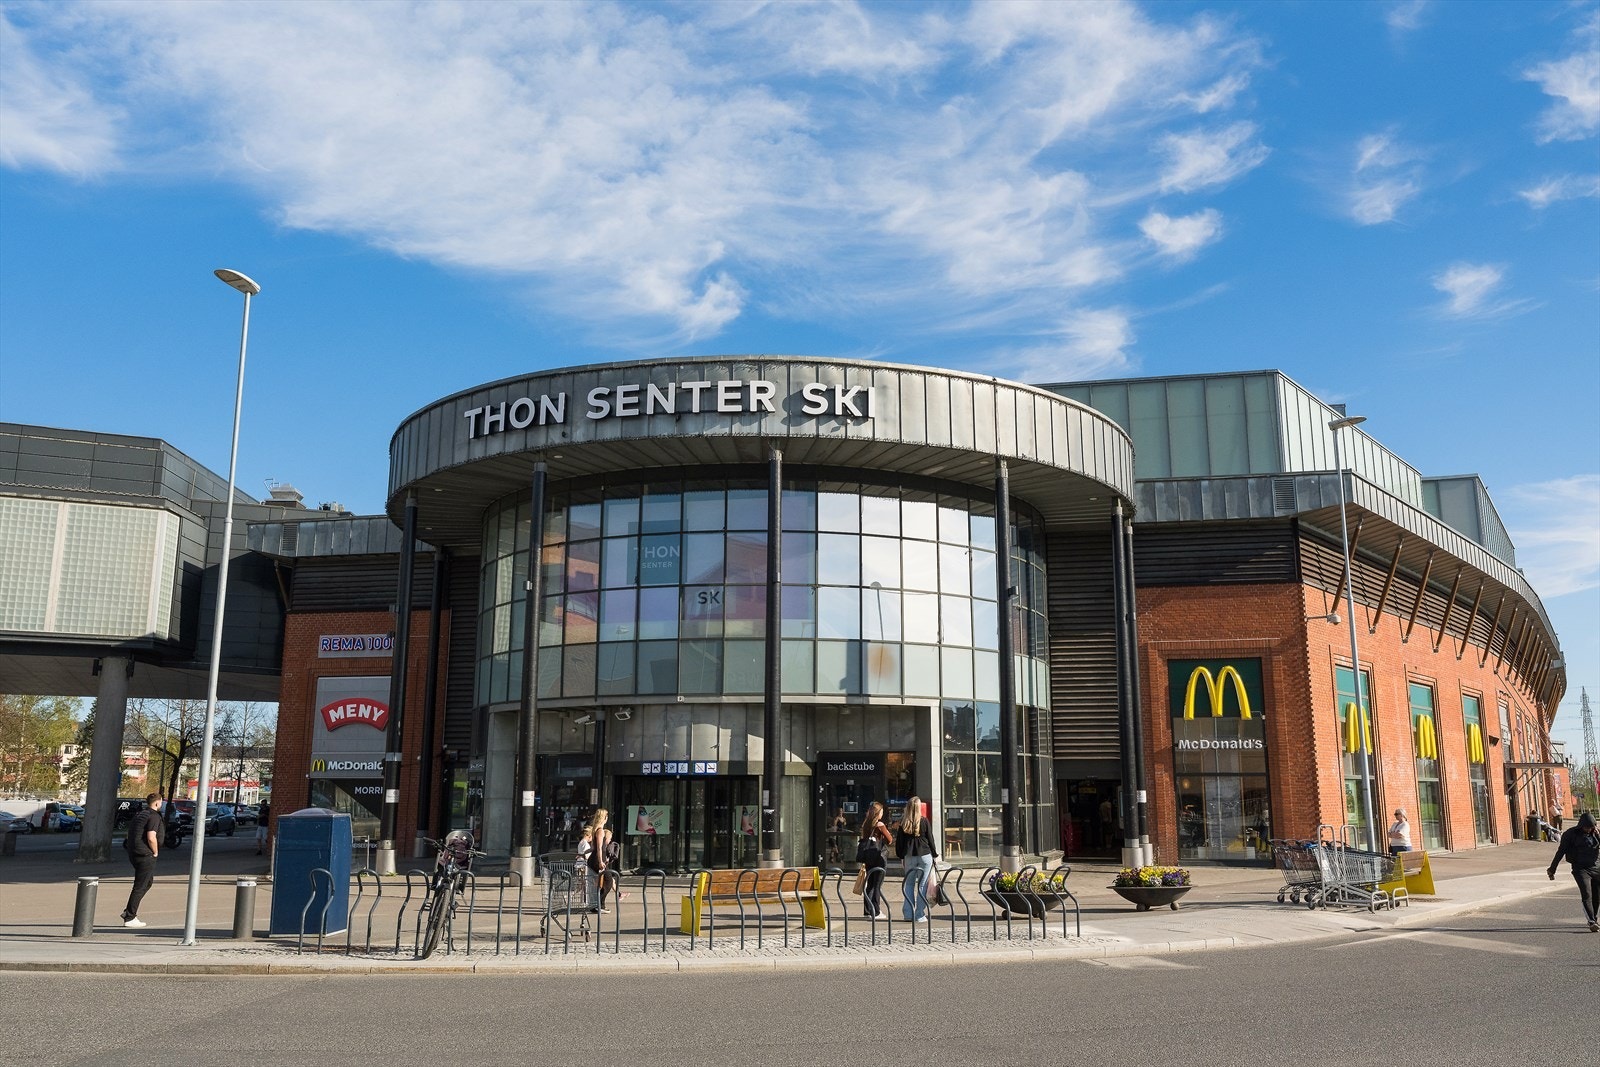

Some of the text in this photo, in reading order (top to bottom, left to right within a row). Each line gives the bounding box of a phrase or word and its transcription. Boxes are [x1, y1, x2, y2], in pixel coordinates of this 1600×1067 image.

[464, 380, 876, 439] THON SENTER SKI
[641, 561, 673, 569] SENTER
[320, 636, 395, 651] REMA 100
[328, 703, 385, 723] MENY
[1178, 738, 1263, 751] McDonald's
[826, 761, 875, 771] backstube
